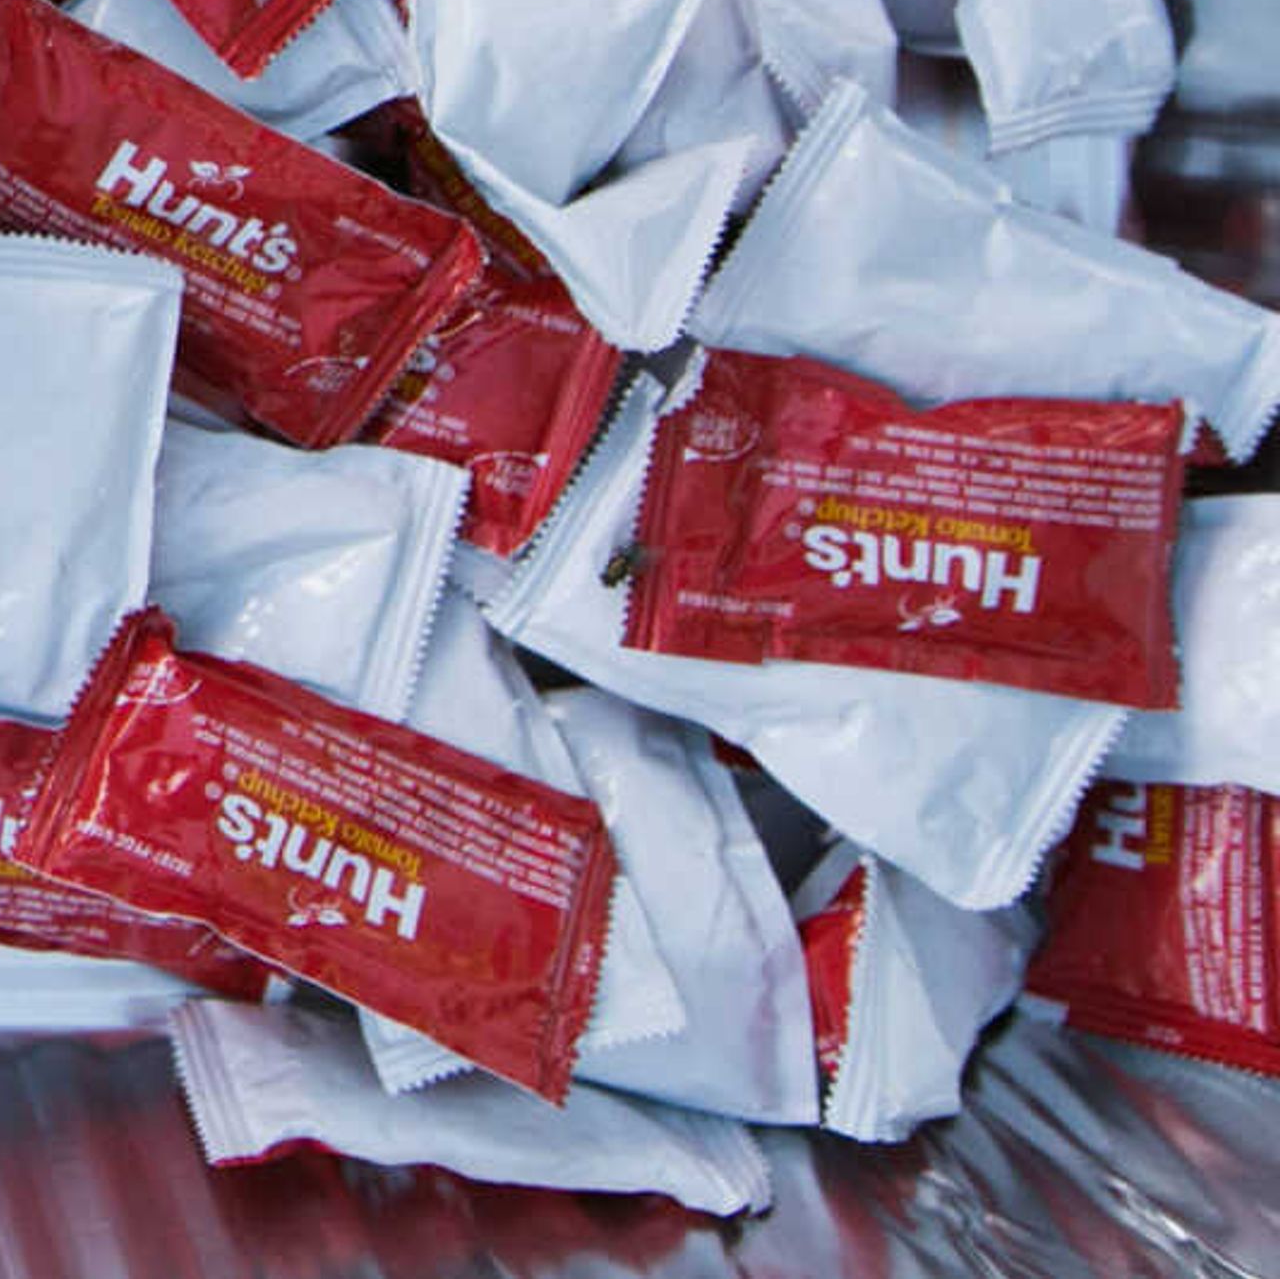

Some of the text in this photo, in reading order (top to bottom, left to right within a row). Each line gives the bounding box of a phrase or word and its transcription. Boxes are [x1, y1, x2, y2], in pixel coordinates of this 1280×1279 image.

[95, 139, 298, 273] Hunt's
[172, 227, 272, 298] Ketchup
[802, 524, 1042, 614] Hunt's
[815, 495, 1035, 554] Tomato Ketchup
[217, 792, 427, 941] Hunt's
[240, 772, 423, 879] Tomato Ketchup
